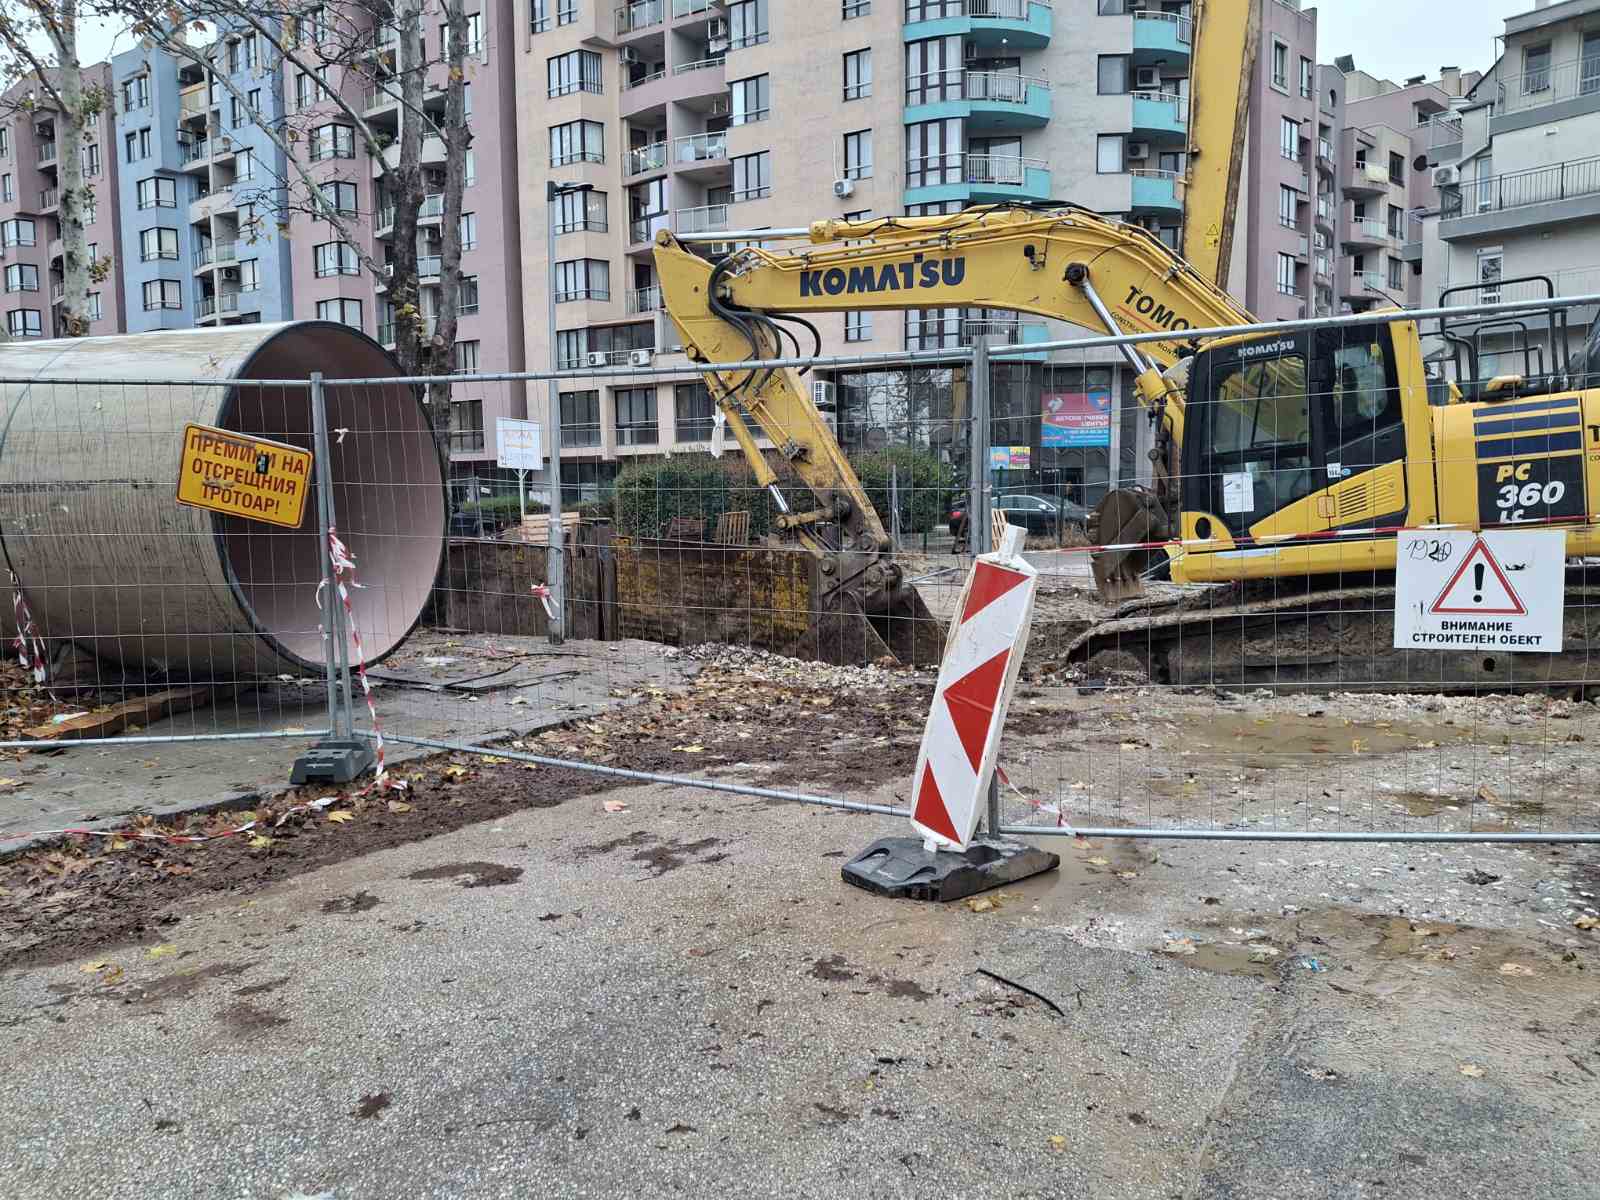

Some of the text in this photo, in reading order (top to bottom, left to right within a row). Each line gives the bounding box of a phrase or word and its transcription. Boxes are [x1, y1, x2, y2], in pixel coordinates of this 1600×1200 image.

[800, 252, 965, 297] KOMATSU
[1123, 285, 1199, 331] TOMO
[1237, 340, 1295, 357] KOMATSU
[282, 455, 304, 475] НА
[1496, 463, 1532, 483] PC
[192, 458, 297, 496] ОТСРЕЩНИЯ
[202, 482, 280, 514] ТРОТОАР!
[1496, 481, 1565, 508] 360
[1499, 509, 1525, 523] LC
[1441, 621, 1513, 632] ВНИМАНИЕ
[1412, 633, 1543, 645] СТРОИТЕЛЕН ОБЕКТ
